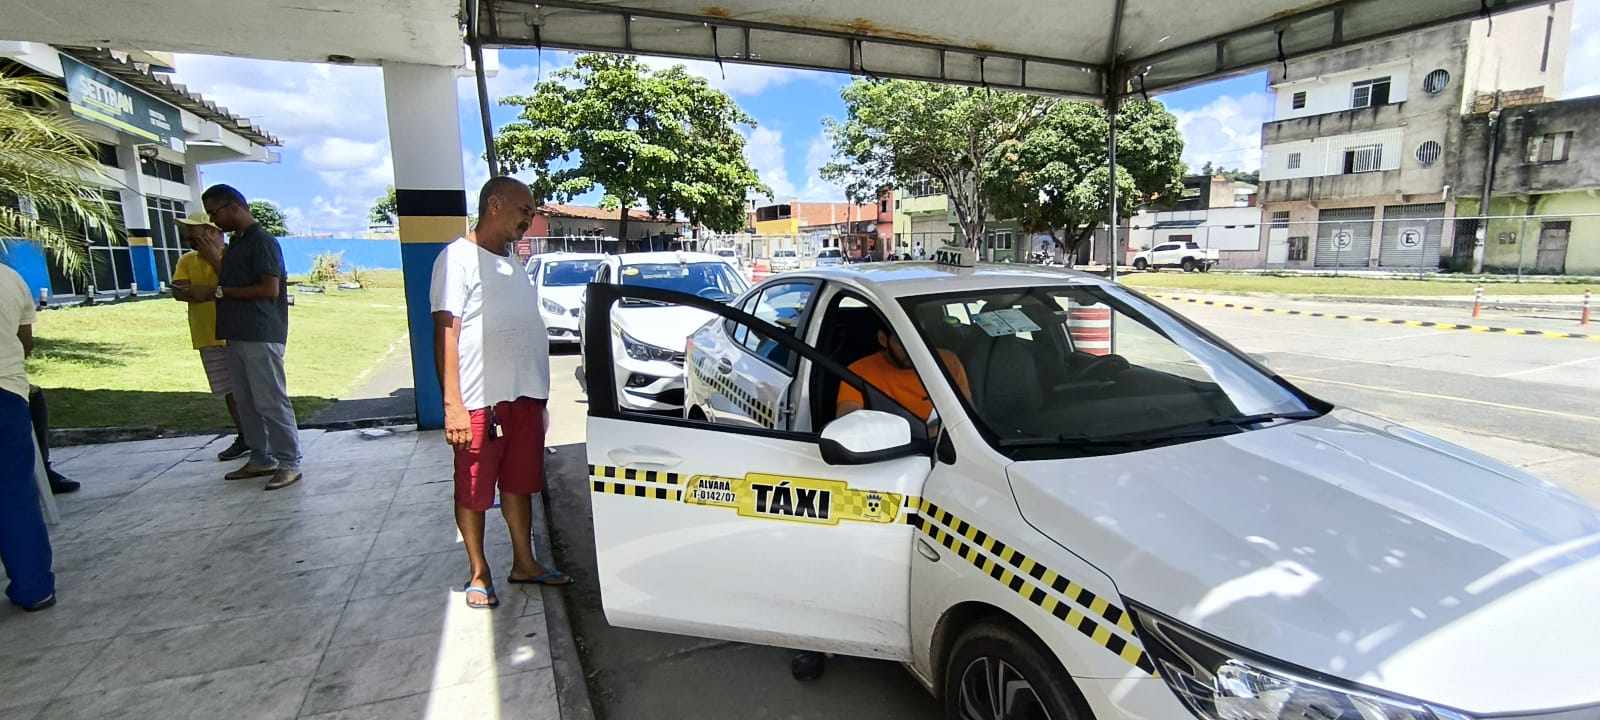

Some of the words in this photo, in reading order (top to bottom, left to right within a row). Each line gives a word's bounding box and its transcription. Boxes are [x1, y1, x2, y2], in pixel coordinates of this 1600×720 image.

[80, 75, 134, 115] SETTRAN
[1405, 233, 1416, 244] E
[936, 250, 961, 265] TAXI
[698, 479, 730, 491] ALVARÁ
[692, 489, 735, 502] T-0142/07
[751, 481, 831, 519] TÁXI
